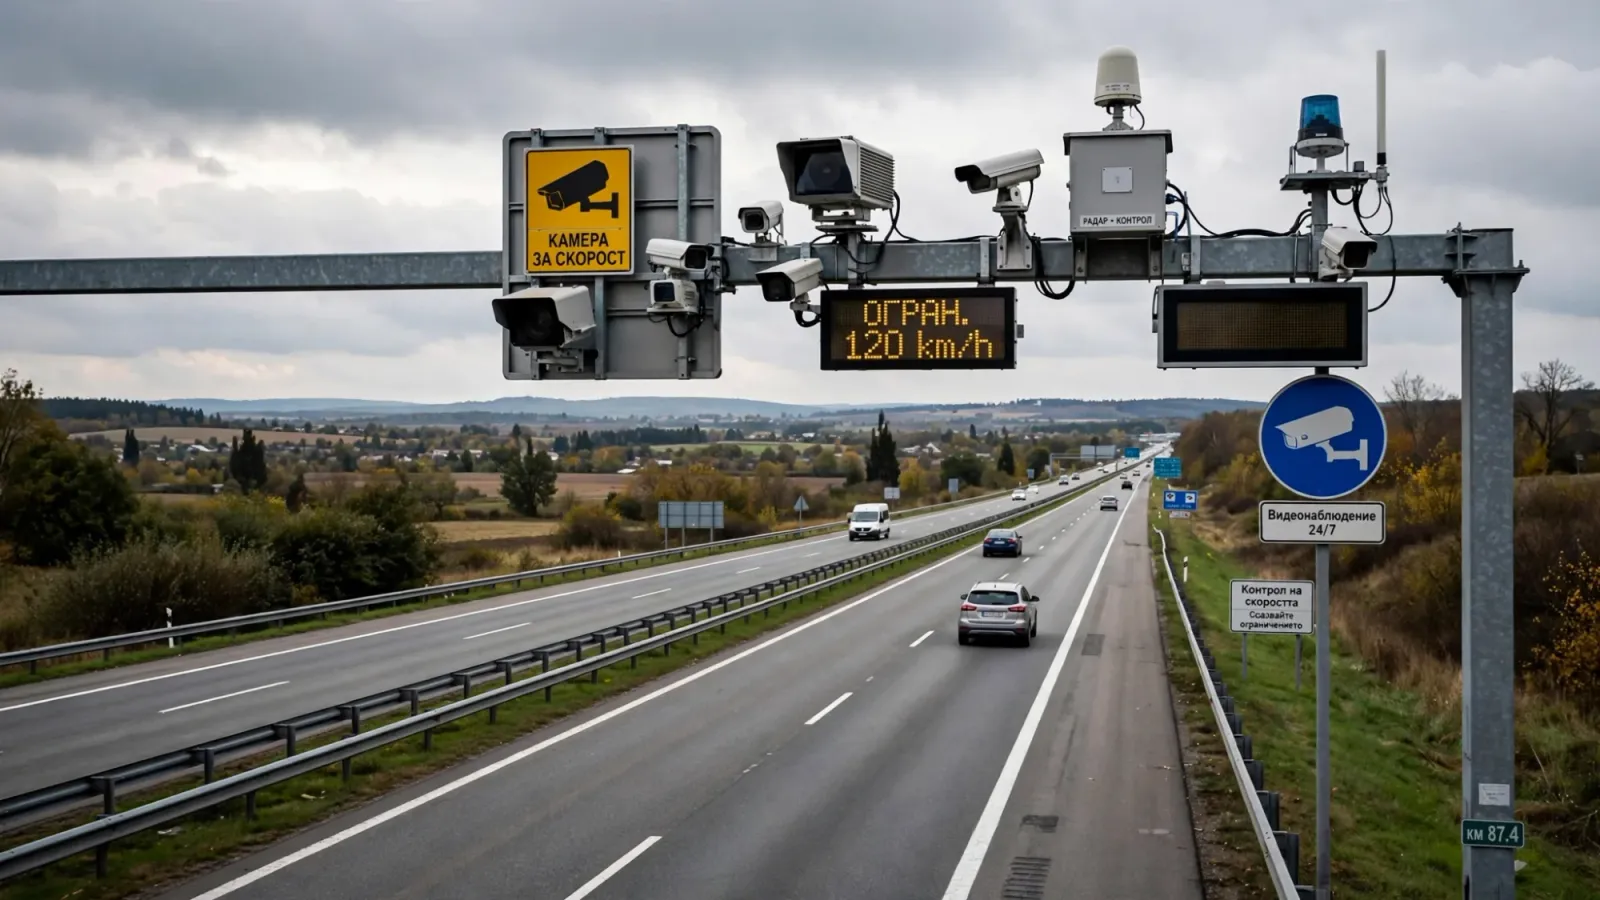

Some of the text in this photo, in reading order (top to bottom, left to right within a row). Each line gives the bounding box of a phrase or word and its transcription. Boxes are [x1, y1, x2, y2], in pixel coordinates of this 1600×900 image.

[1083, 217, 1108, 226] РАДАР
[1116, 216, 1152, 225] КОНТРОЛ
[548, 232, 609, 248] КАМЕРА
[532, 250, 626, 267] ЗА СКОРОСТ
[864, 299, 968, 326] ОГРАН.
[845, 329, 993, 359] 120 km/h
[1267, 509, 1377, 523] Видеонаблюдение
[1308, 523, 1337, 537] 24/7
[1241, 584, 1303, 597] Контрол на
[1245, 598, 1299, 609] скоростта
[1487, 825, 1520, 843] 87.4
